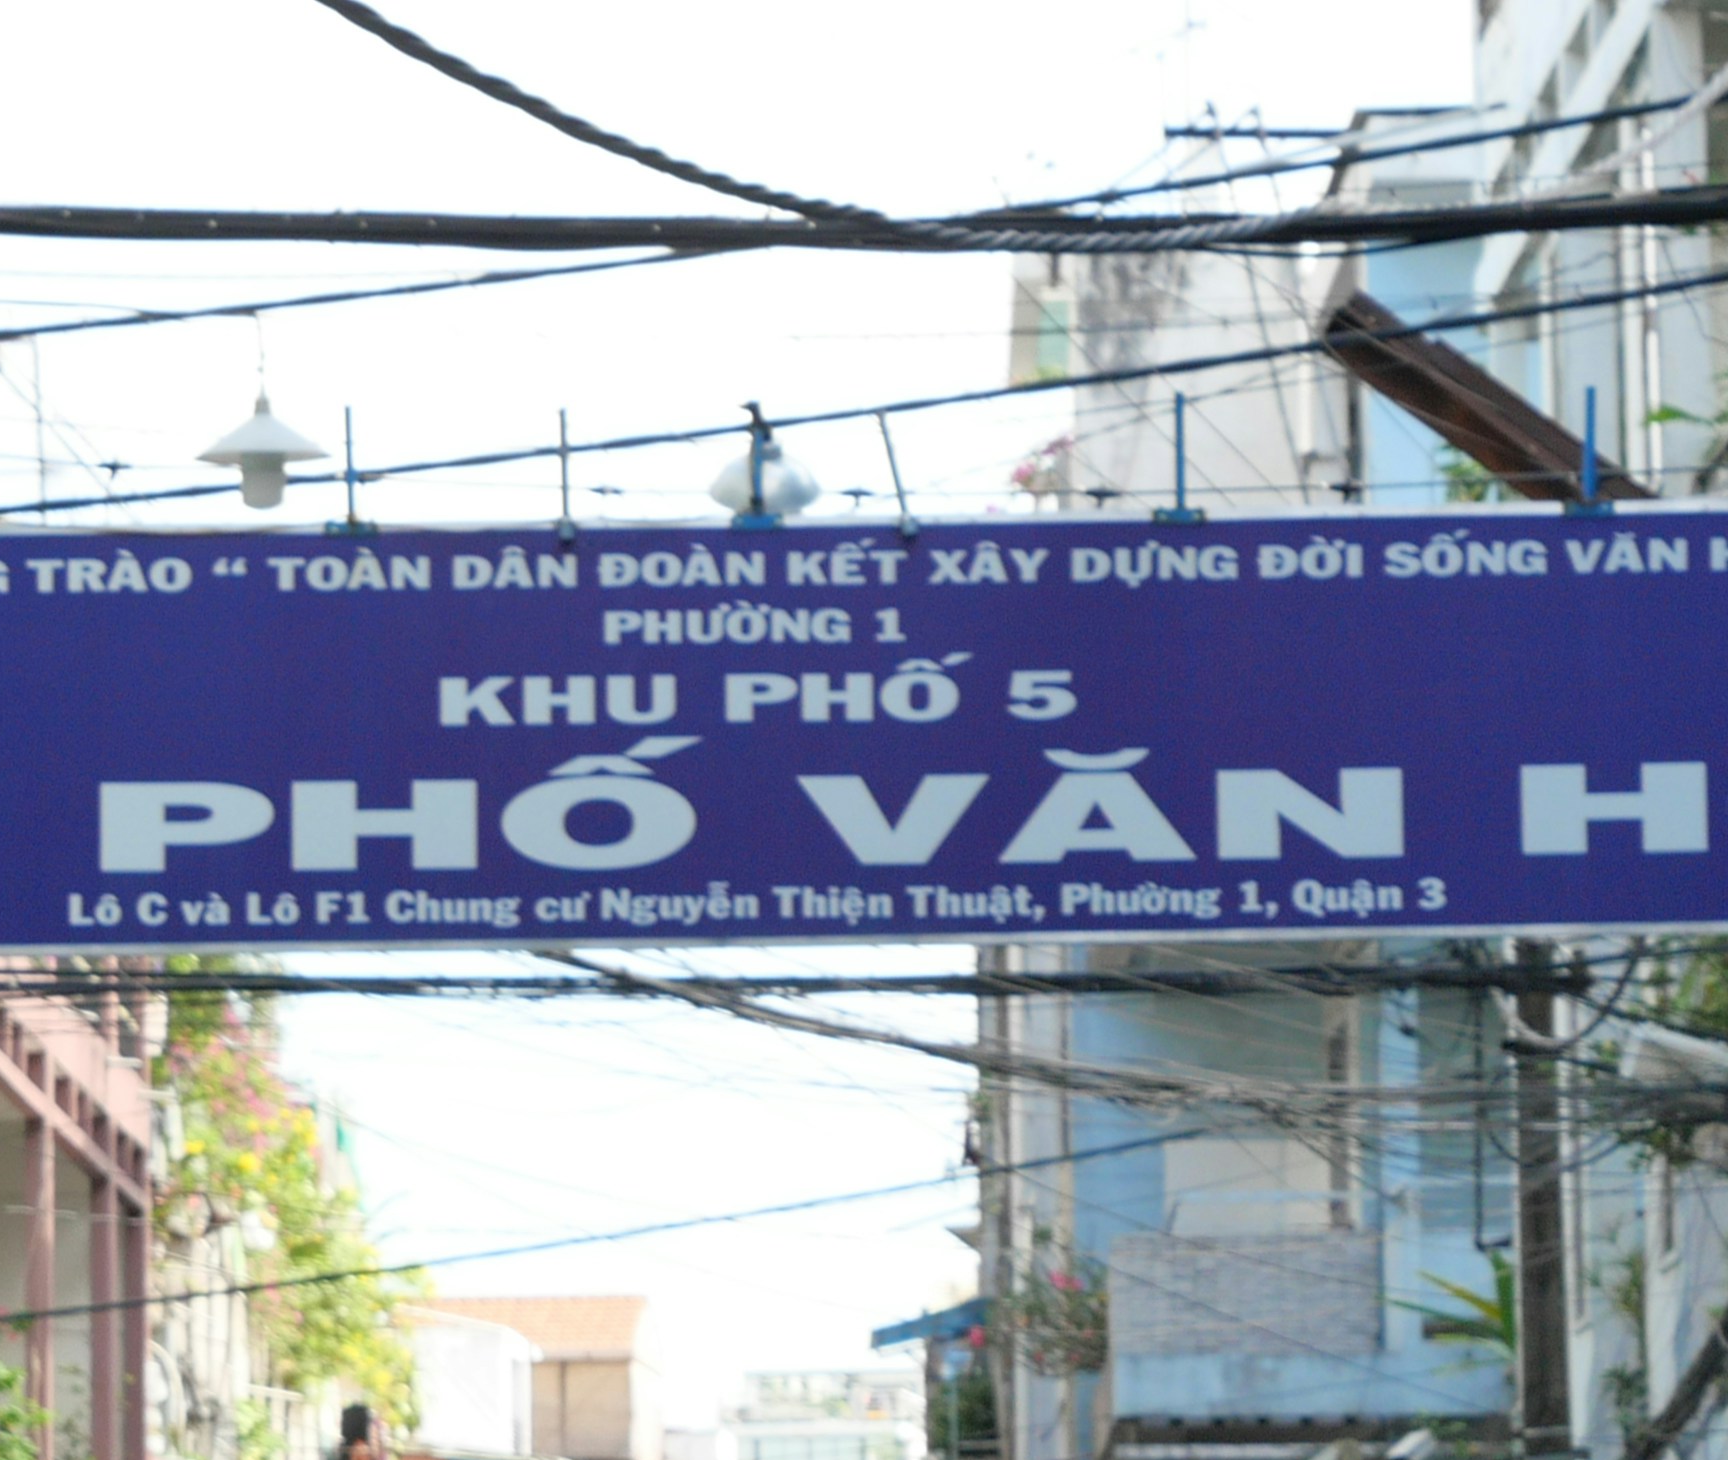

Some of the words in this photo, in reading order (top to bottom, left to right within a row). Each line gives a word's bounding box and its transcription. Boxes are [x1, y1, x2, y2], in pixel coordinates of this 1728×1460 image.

[26, 549, 192, 593] TRÀO
[268, 548, 430, 591] TOÀN
[453, 546, 577, 589] DÂN
[598, 544, 765, 587] ĐOÀN
[787, 537, 907, 586] KẾT
[929, 540, 1048, 584] XÂY
[1071, 541, 1239, 587] DỰNG
[1258, 534, 1363, 579] ĐỜI
[1382, 528, 1548, 578] SỐNG
[1566, 532, 1688, 574] VĂN
[604, 601, 850, 645] PHƯỜNG
[876, 608, 905, 642] 1
[440, 675, 676, 726] KHU
[725, 653, 971, 722] PHỐ
[1009, 671, 1076, 719] 5
[100, 736, 698, 873] PHỐ
[798, 749, 1403, 866] VĂN
[69, 889, 122, 926] Lô
[137, 893, 168, 925] C
[182, 891, 229, 925] và
[247, 889, 299, 925] Lô
[317, 892, 369, 924] F1
[385, 891, 520, 928] Chung
[535, 891, 590, 921] cư
[601, 882, 758, 926] Nguyễn
[773, 887, 893, 925] Thiện
[907, 886, 1045, 923] Thuật,
[1062, 883, 1221, 919] Phường
[1241, 881, 1278, 917] 1,
[1293, 880, 1402, 918] Quận
[1419, 878, 1446, 909] 3
